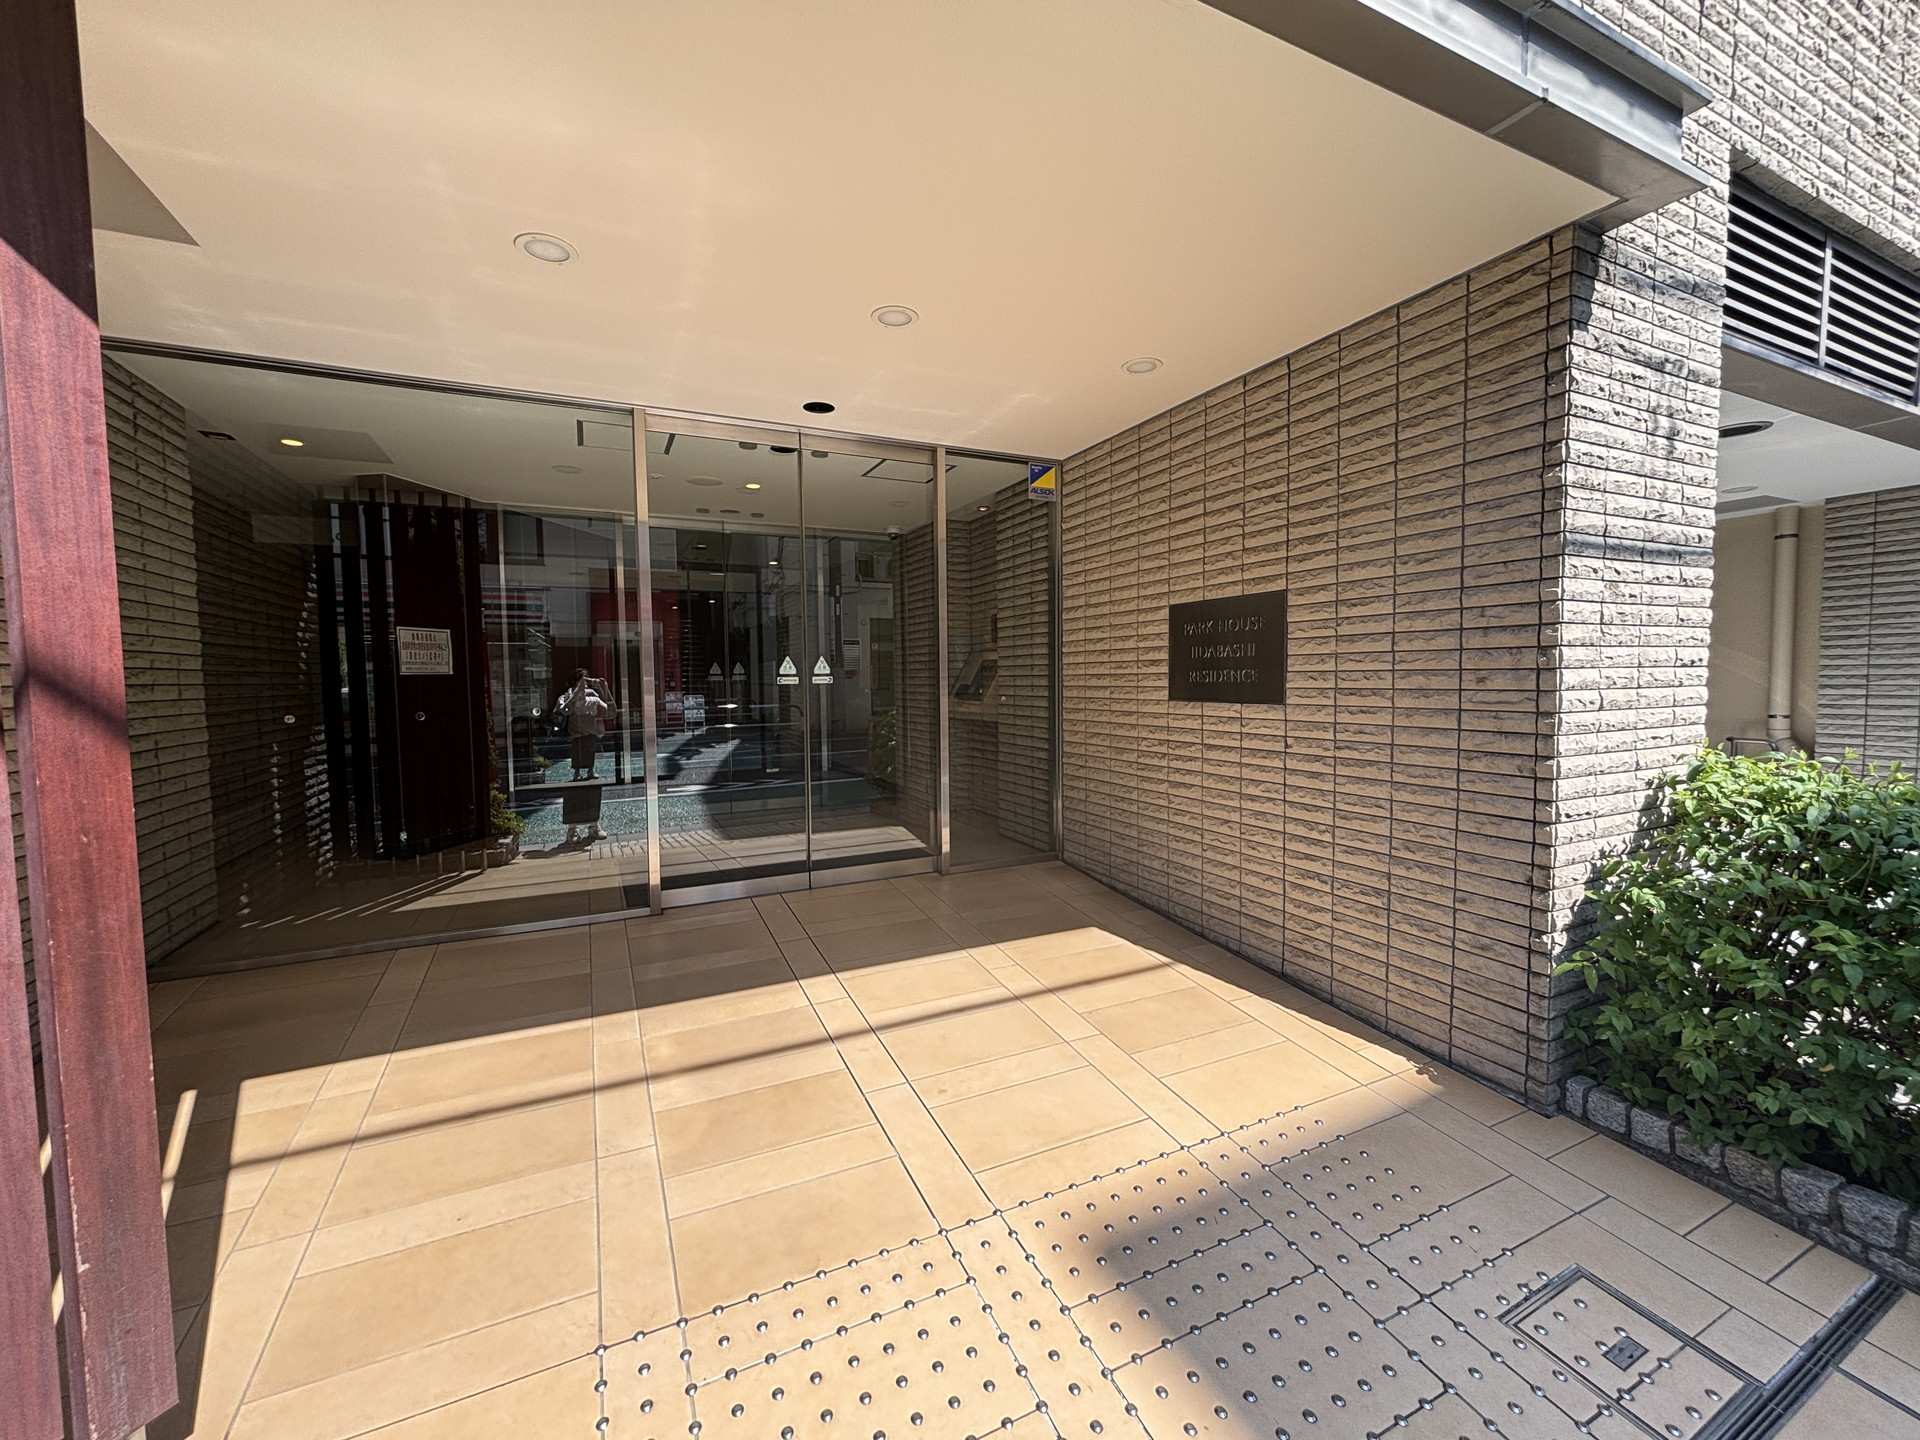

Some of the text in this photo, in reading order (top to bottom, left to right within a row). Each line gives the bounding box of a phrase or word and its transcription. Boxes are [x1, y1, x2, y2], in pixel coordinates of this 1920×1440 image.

[1030, 487, 1055, 496] ALSOK
[1183, 615, 1266, 636] PARK HOUSE
[1191, 642, 1256, 659] IIDABASHI
[1189, 668, 1259, 683] RESIDENCE
